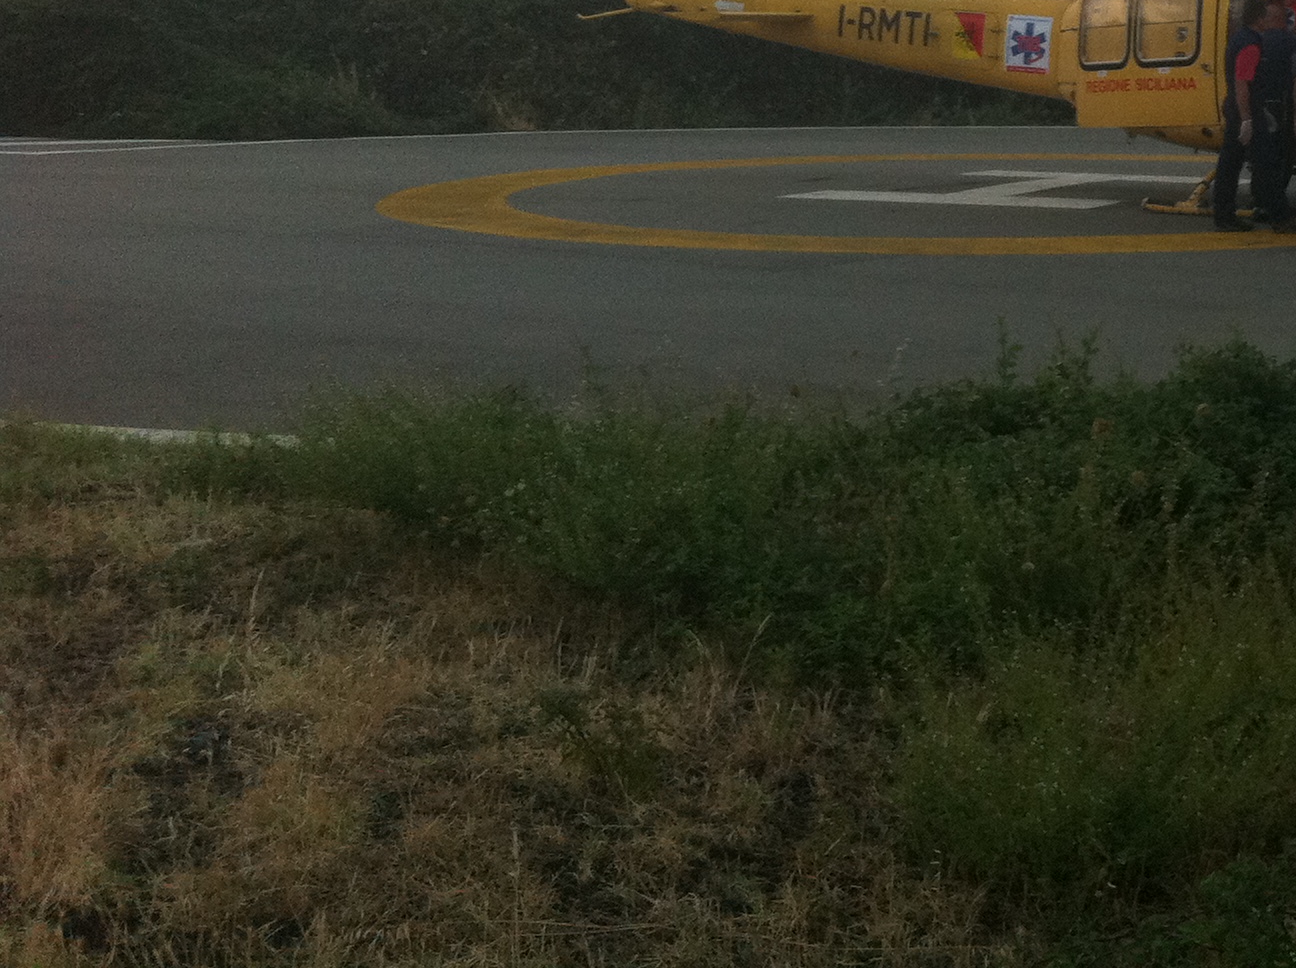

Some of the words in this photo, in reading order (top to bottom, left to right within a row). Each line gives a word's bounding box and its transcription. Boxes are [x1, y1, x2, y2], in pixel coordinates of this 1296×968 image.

[838, 4, 933, 47] I-RMTI
[1086, 79, 1130, 93] REGIONE
[1135, 77, 1198, 91] SICILIANA
